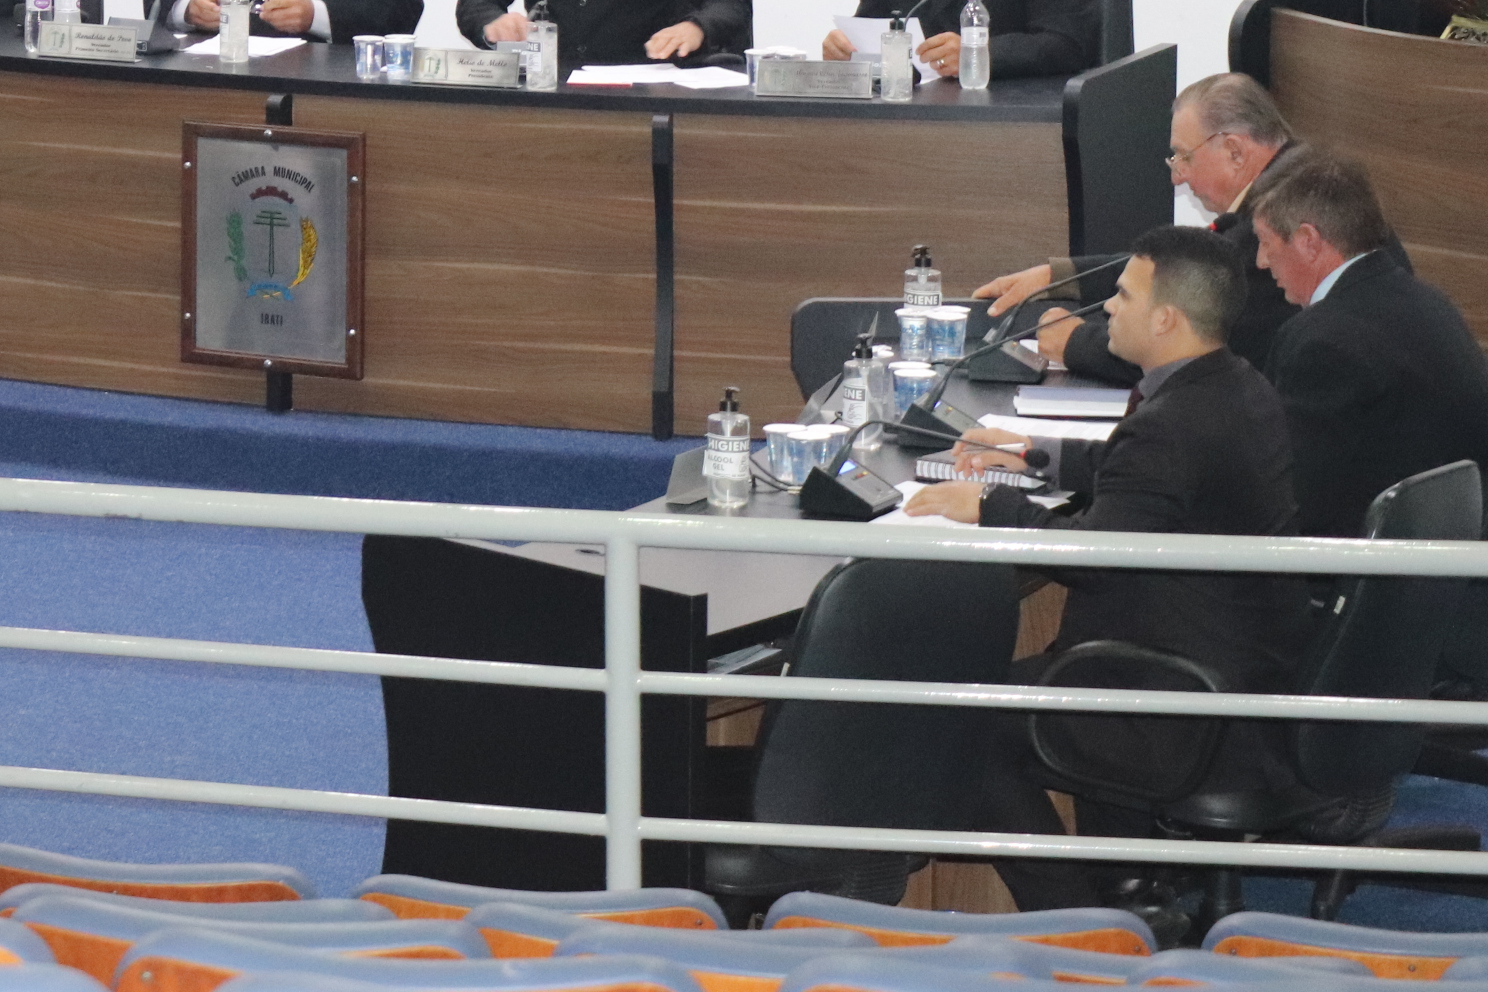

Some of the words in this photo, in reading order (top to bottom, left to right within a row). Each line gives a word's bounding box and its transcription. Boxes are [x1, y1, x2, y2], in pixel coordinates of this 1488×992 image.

[231, 166, 266, 187] CÂMARA
[273, 166, 315, 193] MUNICIPAL
[261, 313, 283, 326] IRATI
